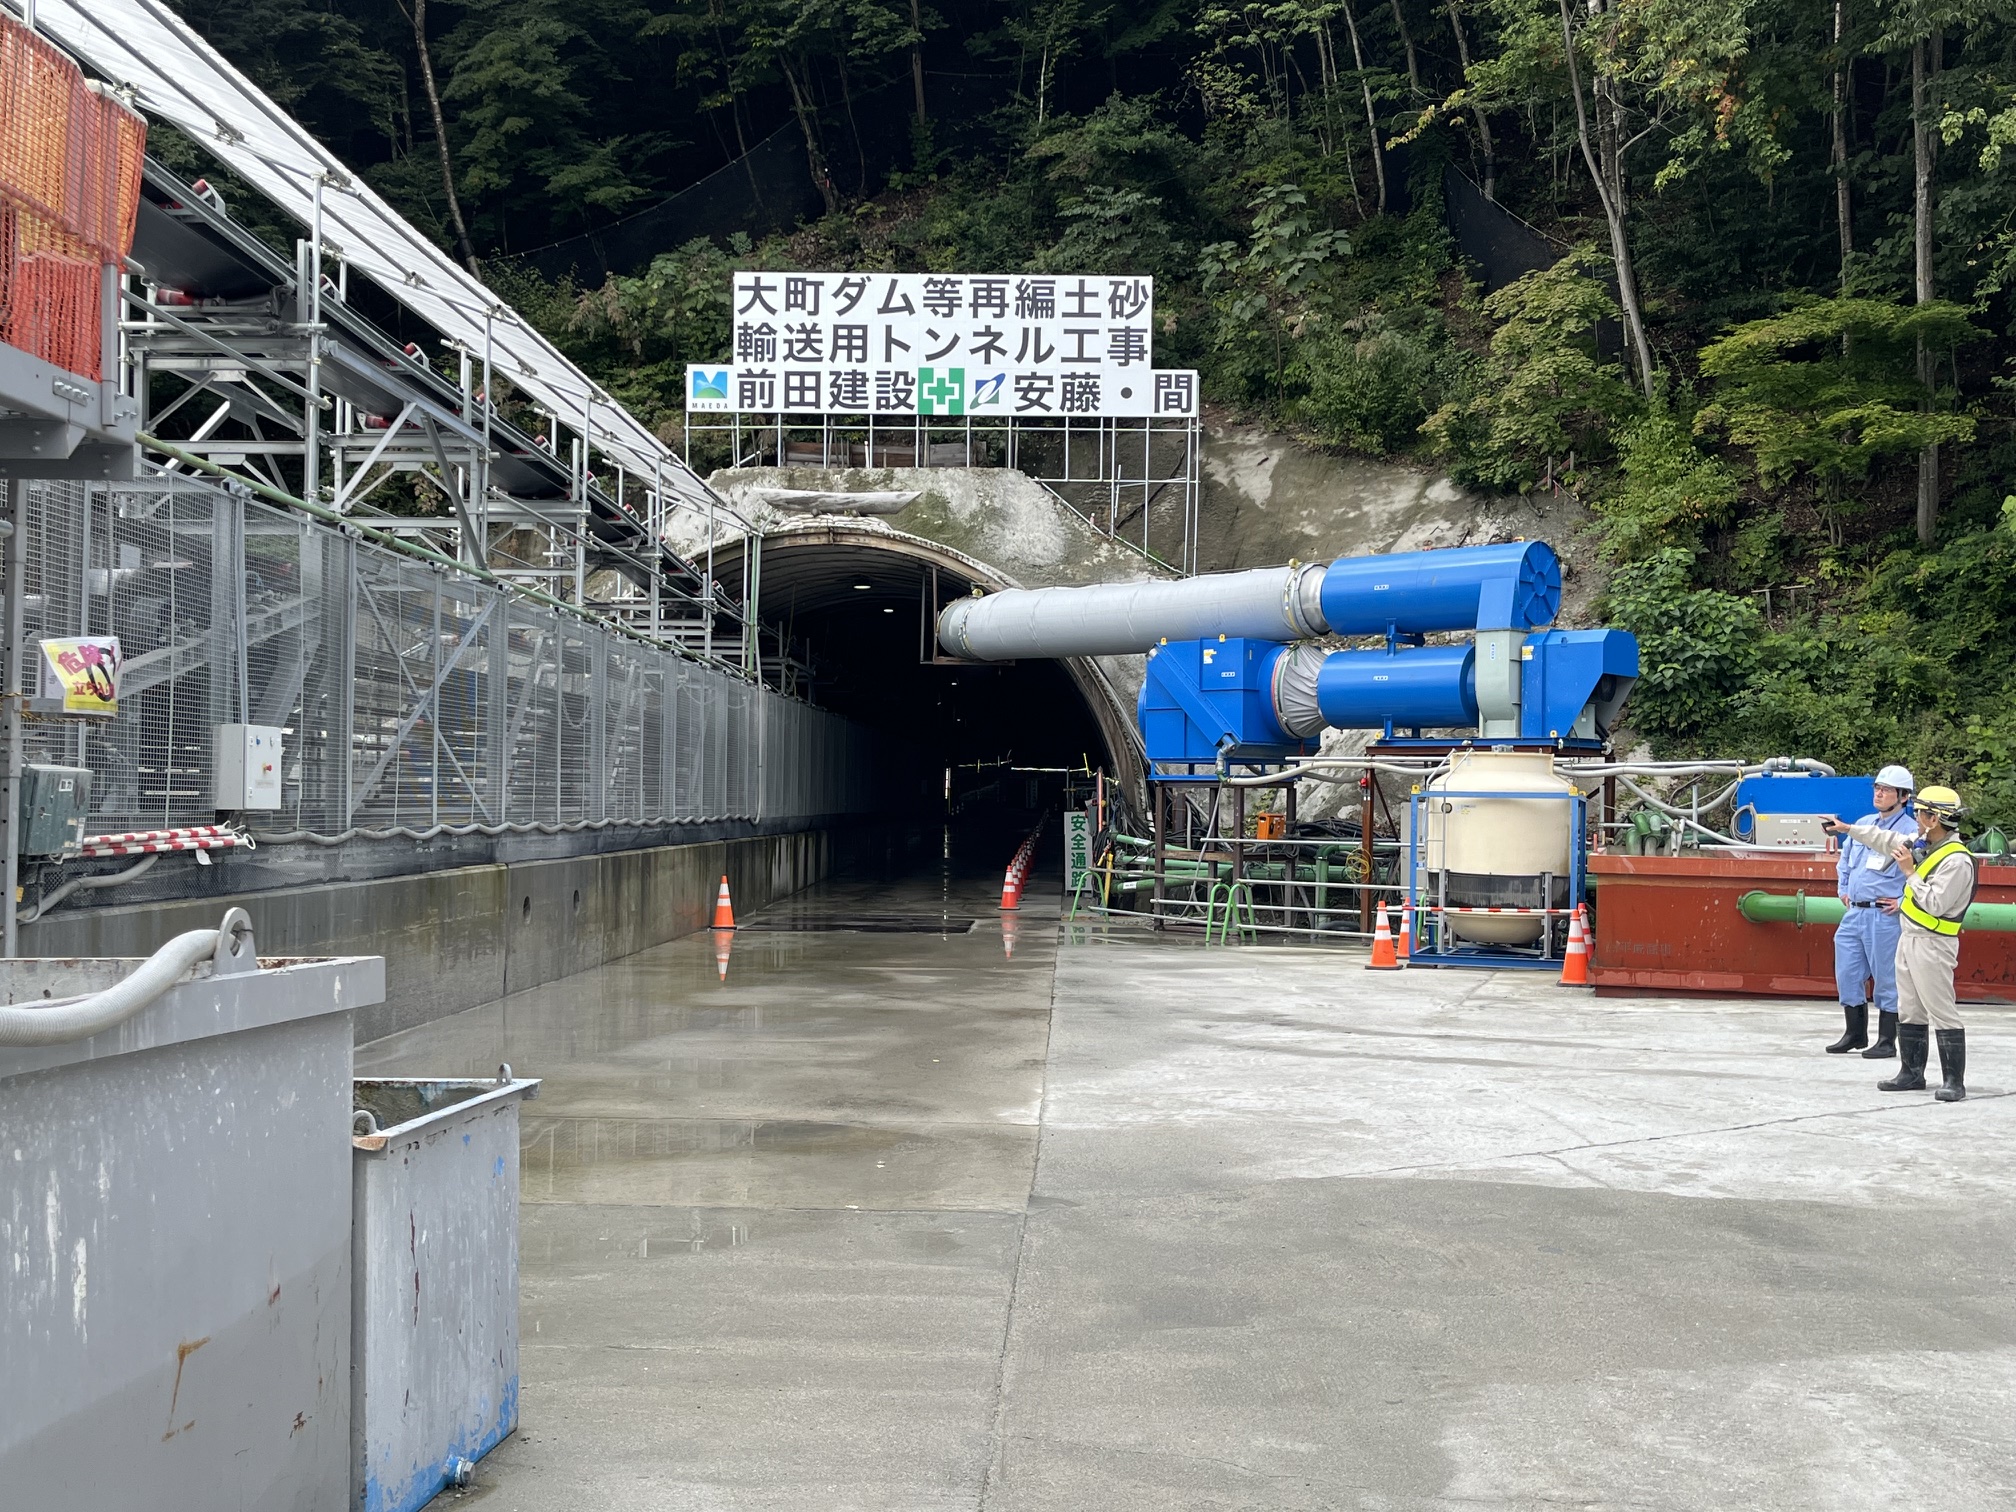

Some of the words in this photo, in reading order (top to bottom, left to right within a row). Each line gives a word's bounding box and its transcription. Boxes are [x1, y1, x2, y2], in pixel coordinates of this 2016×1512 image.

[737, 276, 1150, 319] 大町ダム等再編土砂
[737, 322, 1148, 367] 輸送用トンネル工事
[691, 402, 728, 410] MAEDA
[737, 368, 916, 411] 前田建設
[1071, 814, 1086, 888] 安全通路
